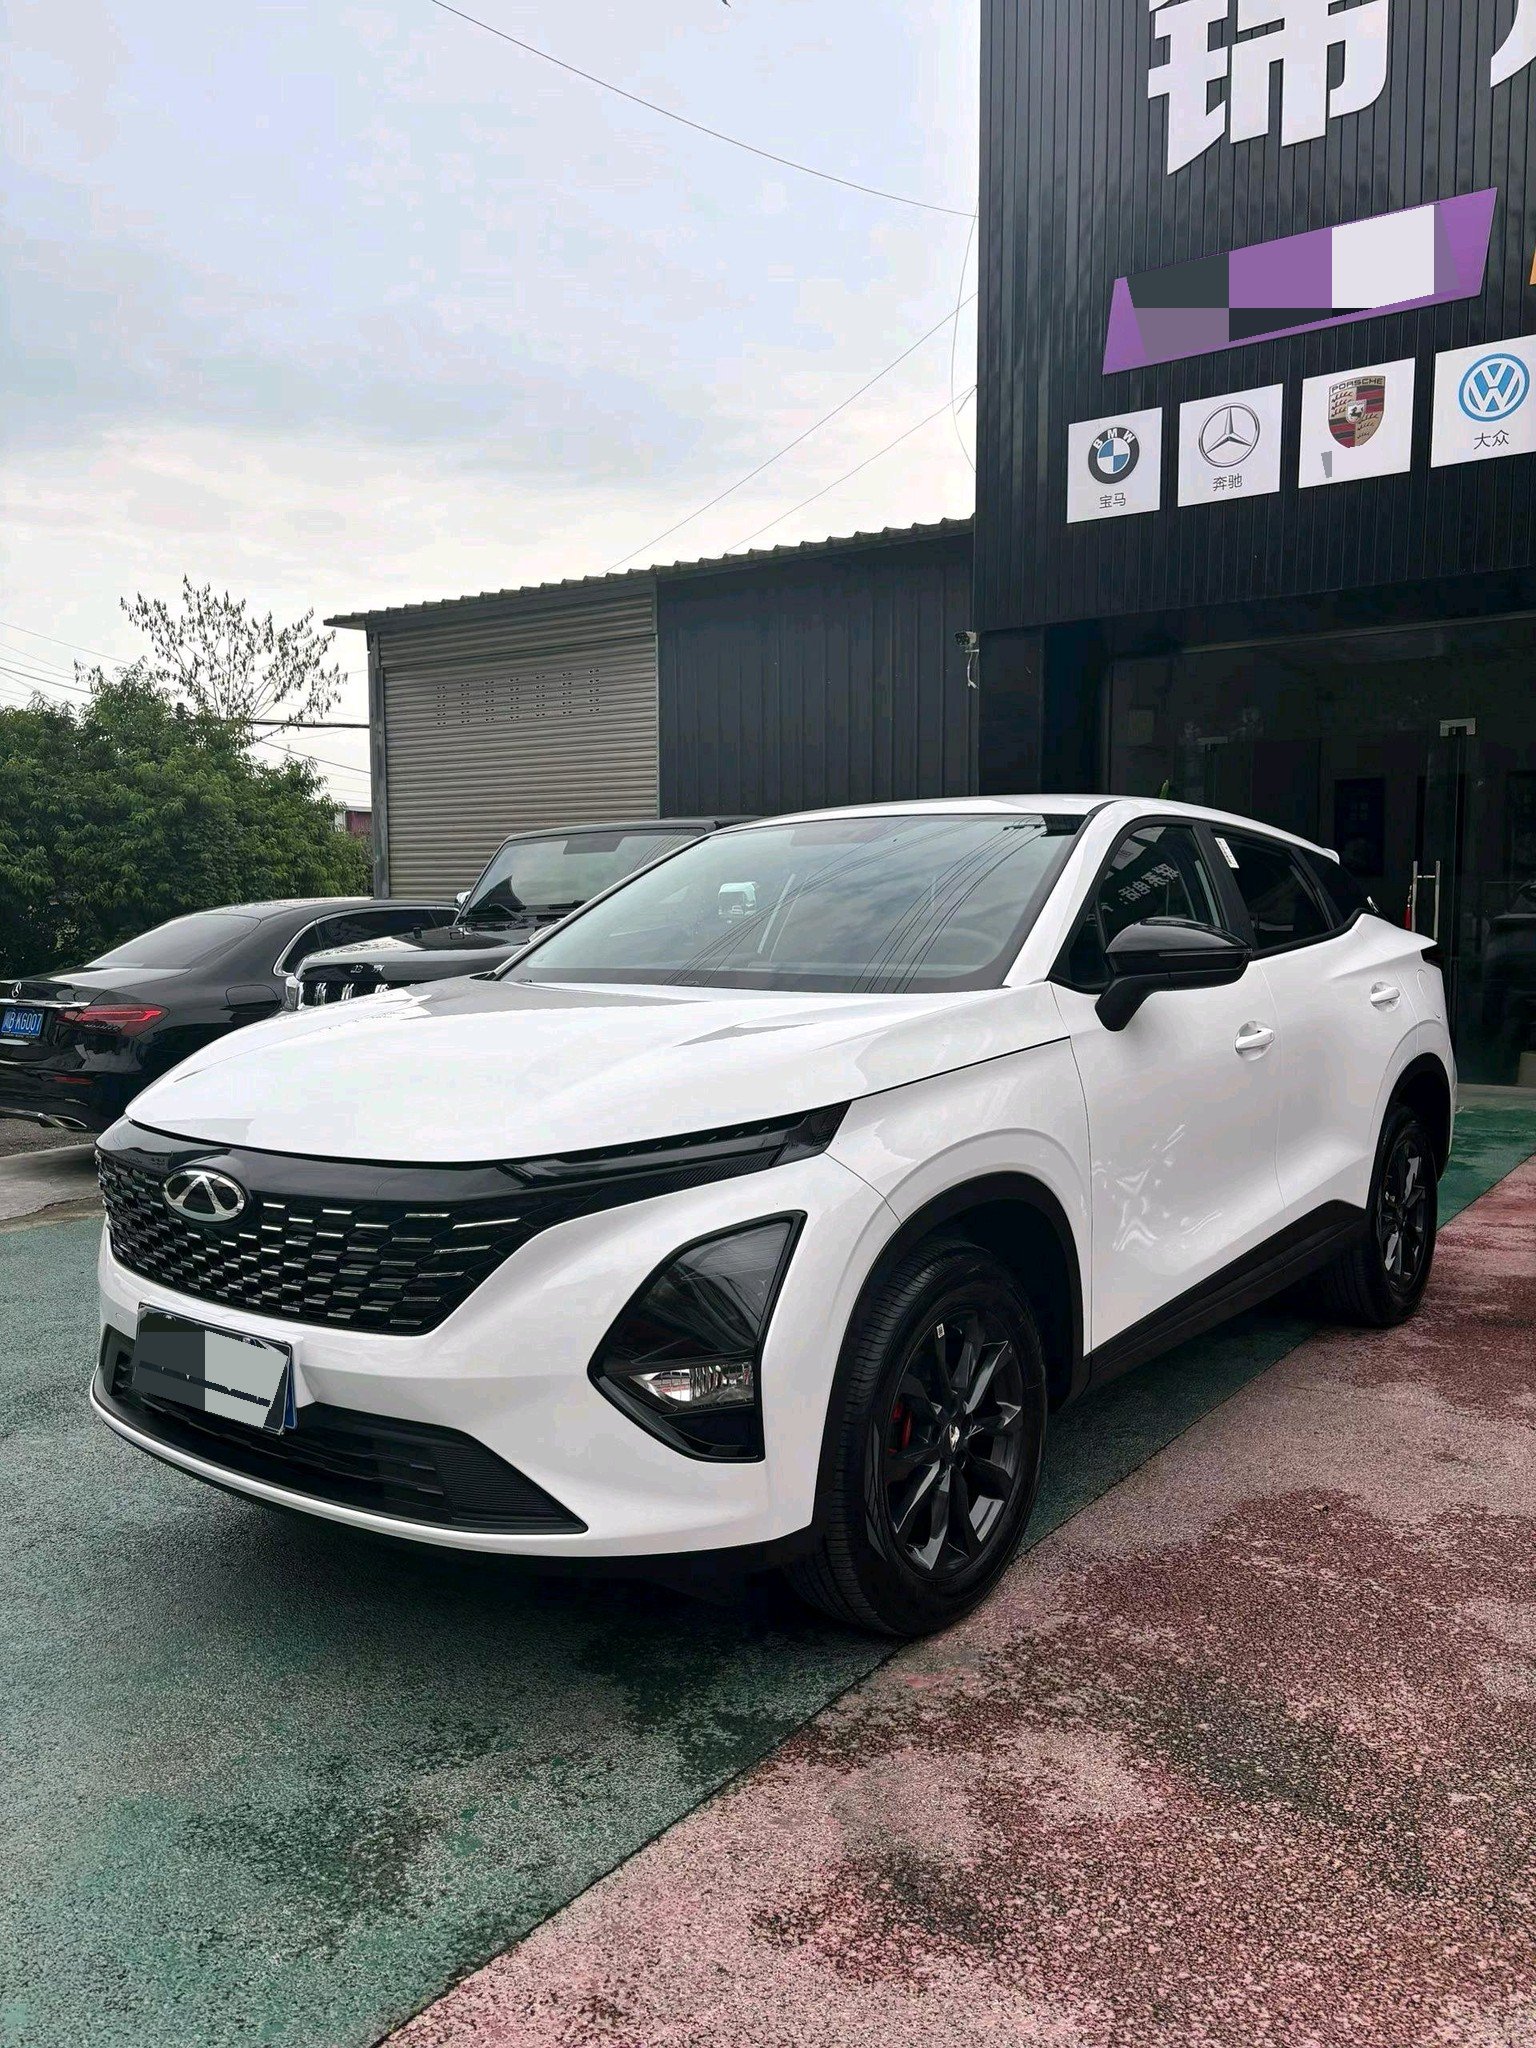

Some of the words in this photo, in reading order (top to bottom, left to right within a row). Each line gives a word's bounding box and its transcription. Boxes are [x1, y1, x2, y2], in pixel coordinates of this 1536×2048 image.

[1148, 0, 1536, 175] 锦
[1331, 376, 1384, 391] PORSCHE
[1093, 428, 1136, 450] BMW
[1473, 429, 1510, 450] 大众
[1212, 472, 1243, 492] 奔驰
[1099, 492, 1126, 509] 宝马
